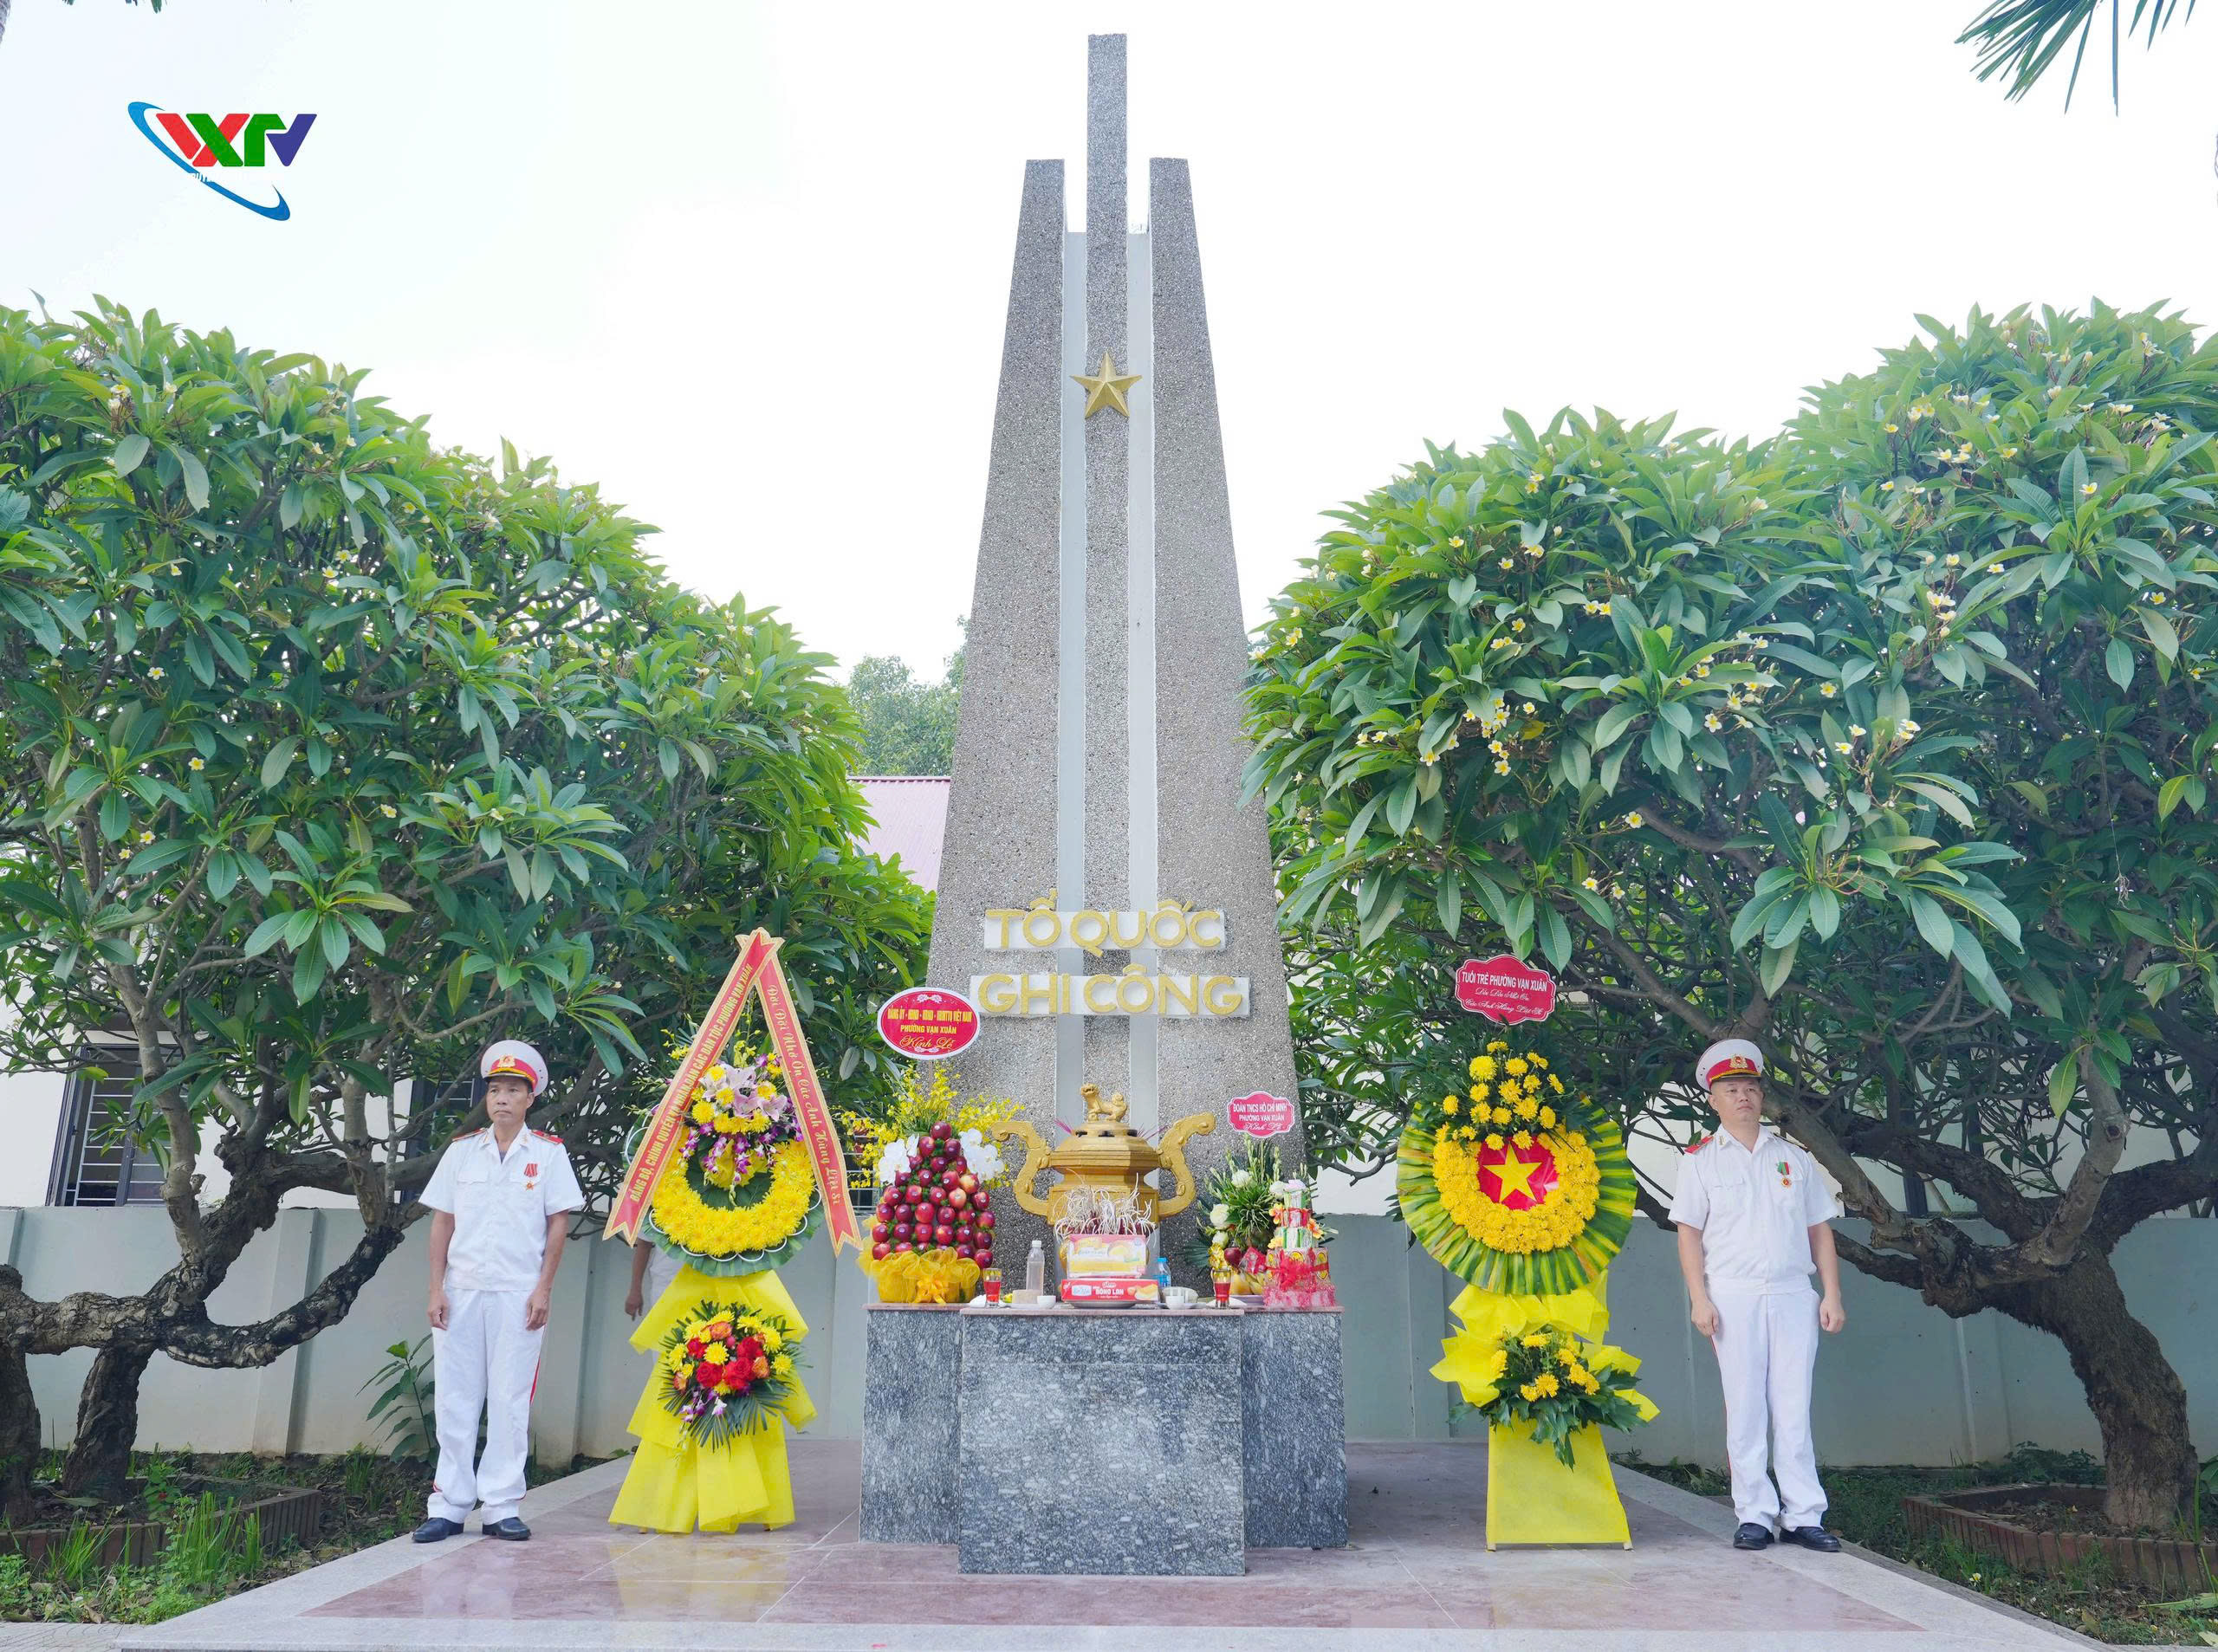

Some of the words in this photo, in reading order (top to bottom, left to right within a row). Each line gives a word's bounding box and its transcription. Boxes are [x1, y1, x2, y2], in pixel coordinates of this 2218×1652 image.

[986, 888, 1061, 949] TỔ
[1070, 899, 1222, 957] QUỐC
[978, 973, 1071, 1015] GHI
[1083, 963, 1242, 1015] CÔNG
[1462, 970, 1475, 983] TUỔI
[1476, 973, 1488, 984] TRẺ
[1490, 974, 1516, 988] PHƯỜNG
[1518, 978, 1529, 991] VẠN
[1531, 979, 1547, 992] XUÂN
[900, 1023, 924, 1033] PHƯỜNG
[926, 1026, 938, 1034] VẠN
[940, 1025, 957, 1033] XUÂN
[645, 1141, 665, 1167] CHÍNH
[656, 1116, 677, 1142] QUYỀN
[693, 1053, 708, 1070] CÁC
[701, 1039, 717, 1054] DÂN
[710, 1024, 723, 1039] TỘC
[717, 996, 737, 1026] PHƯỜNG
[731, 982, 744, 998] VẠN
[739, 963, 752, 984] XUÂN
[1234, 1102, 1246, 1112] ĐOÀN
[1259, 1101, 1266, 1112] HỒ
[1275, 1103, 1287, 1111] MINH
[806, 1102, 821, 1128] Anh
[814, 1130, 829, 1164] Hùng
